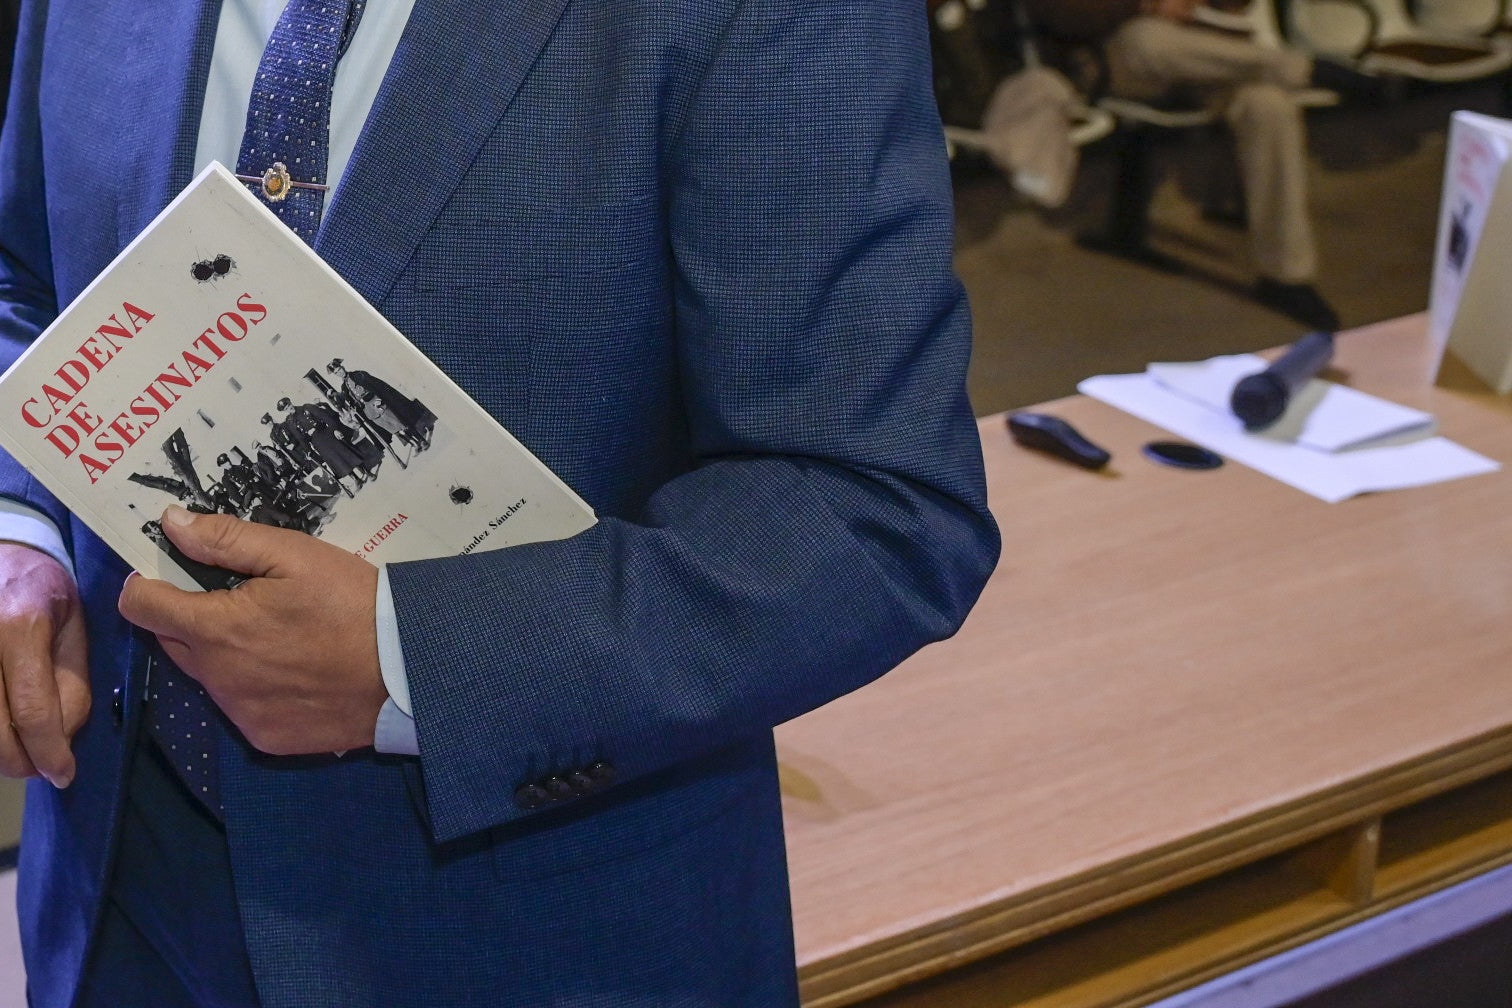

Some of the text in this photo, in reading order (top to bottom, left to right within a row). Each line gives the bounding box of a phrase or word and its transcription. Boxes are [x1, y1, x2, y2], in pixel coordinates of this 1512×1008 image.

[21, 301, 156, 428] CADENA
[78, 292, 267, 484] ASESINATOS
[44, 401, 104, 459] DE
[363, 512, 409, 553] GUERRA
[488, 496, 527, 530] Sánchez
